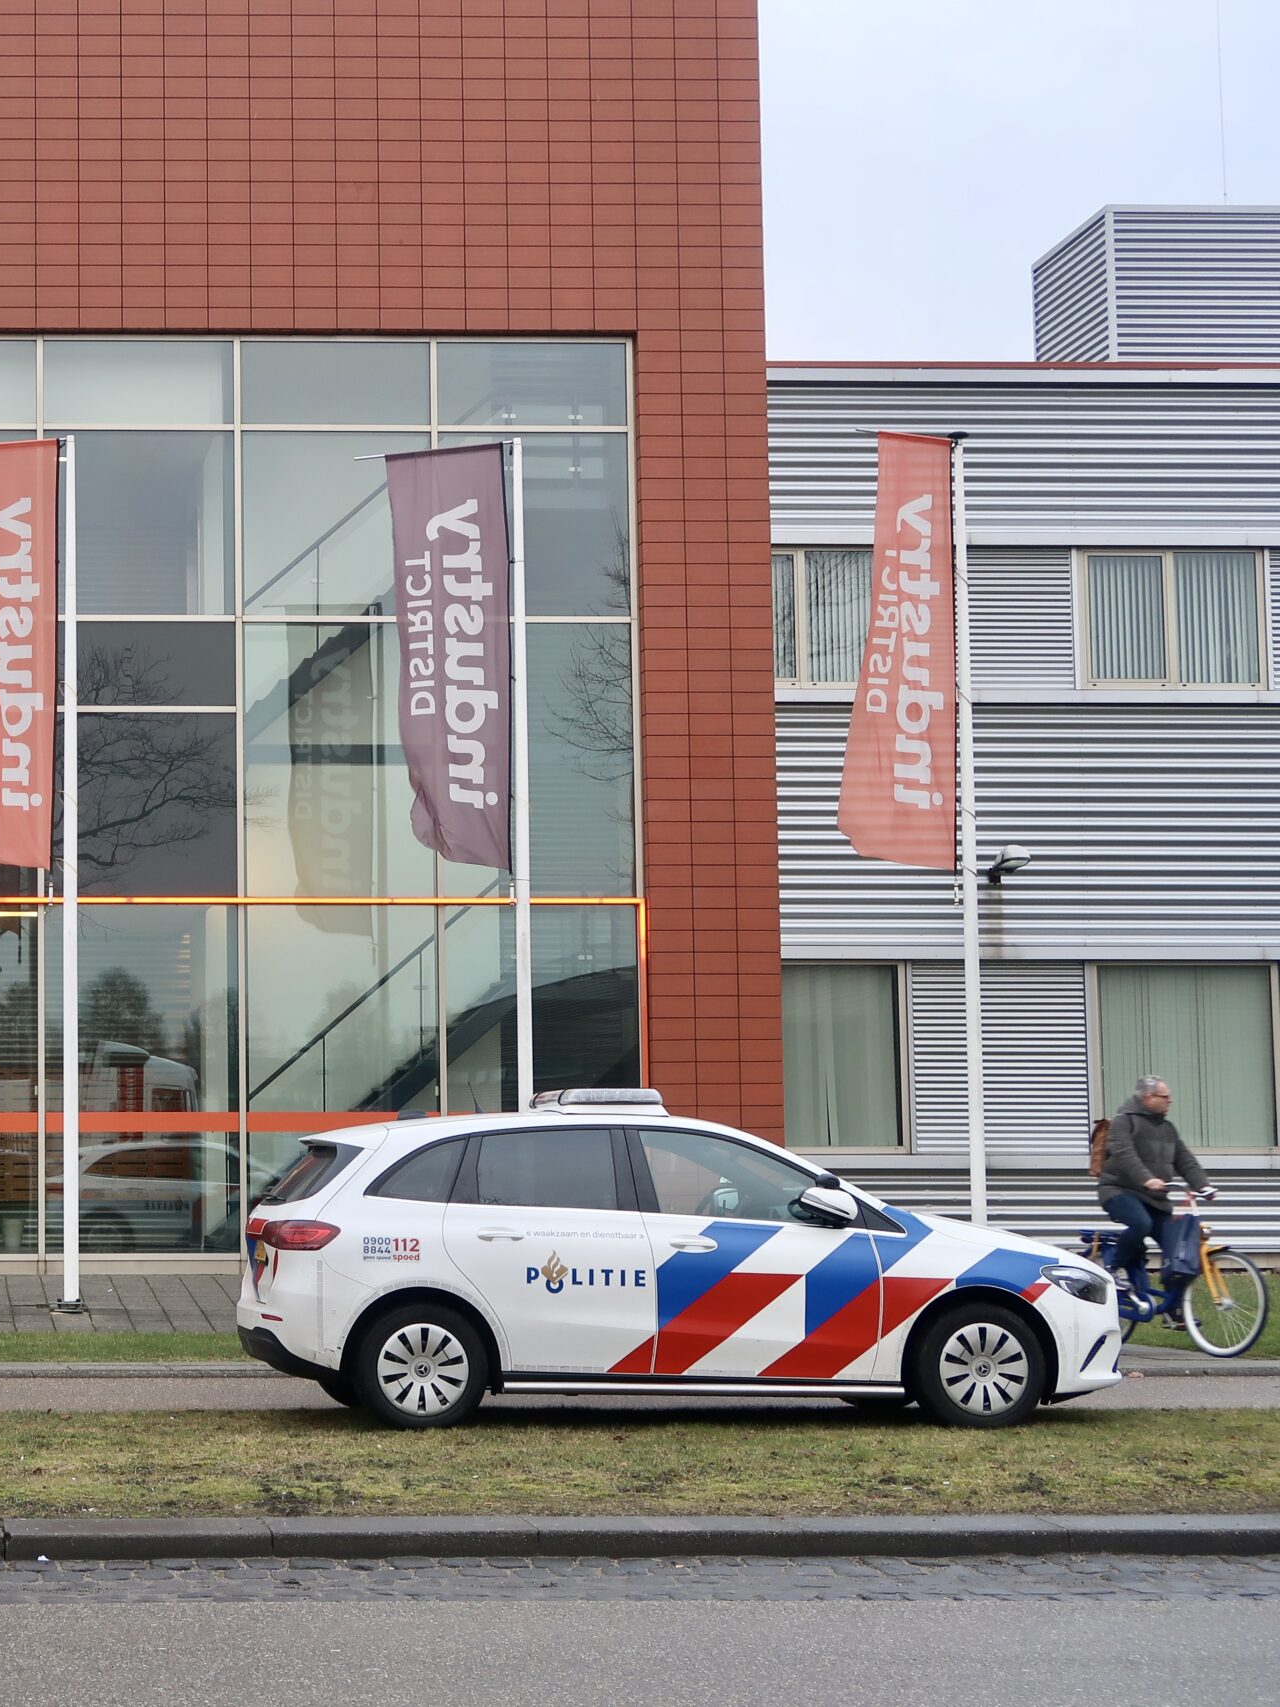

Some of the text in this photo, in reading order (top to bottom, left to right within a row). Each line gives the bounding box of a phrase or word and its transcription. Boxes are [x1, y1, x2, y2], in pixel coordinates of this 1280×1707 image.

[592, 1231, 637, 1239] dienstbaar
[363, 1236, 420, 1252] 0900 112
[363, 1245, 391, 1254] 8844
[392, 1253, 420, 1262] spoed
[526, 1266, 646, 1294] POLITIE
